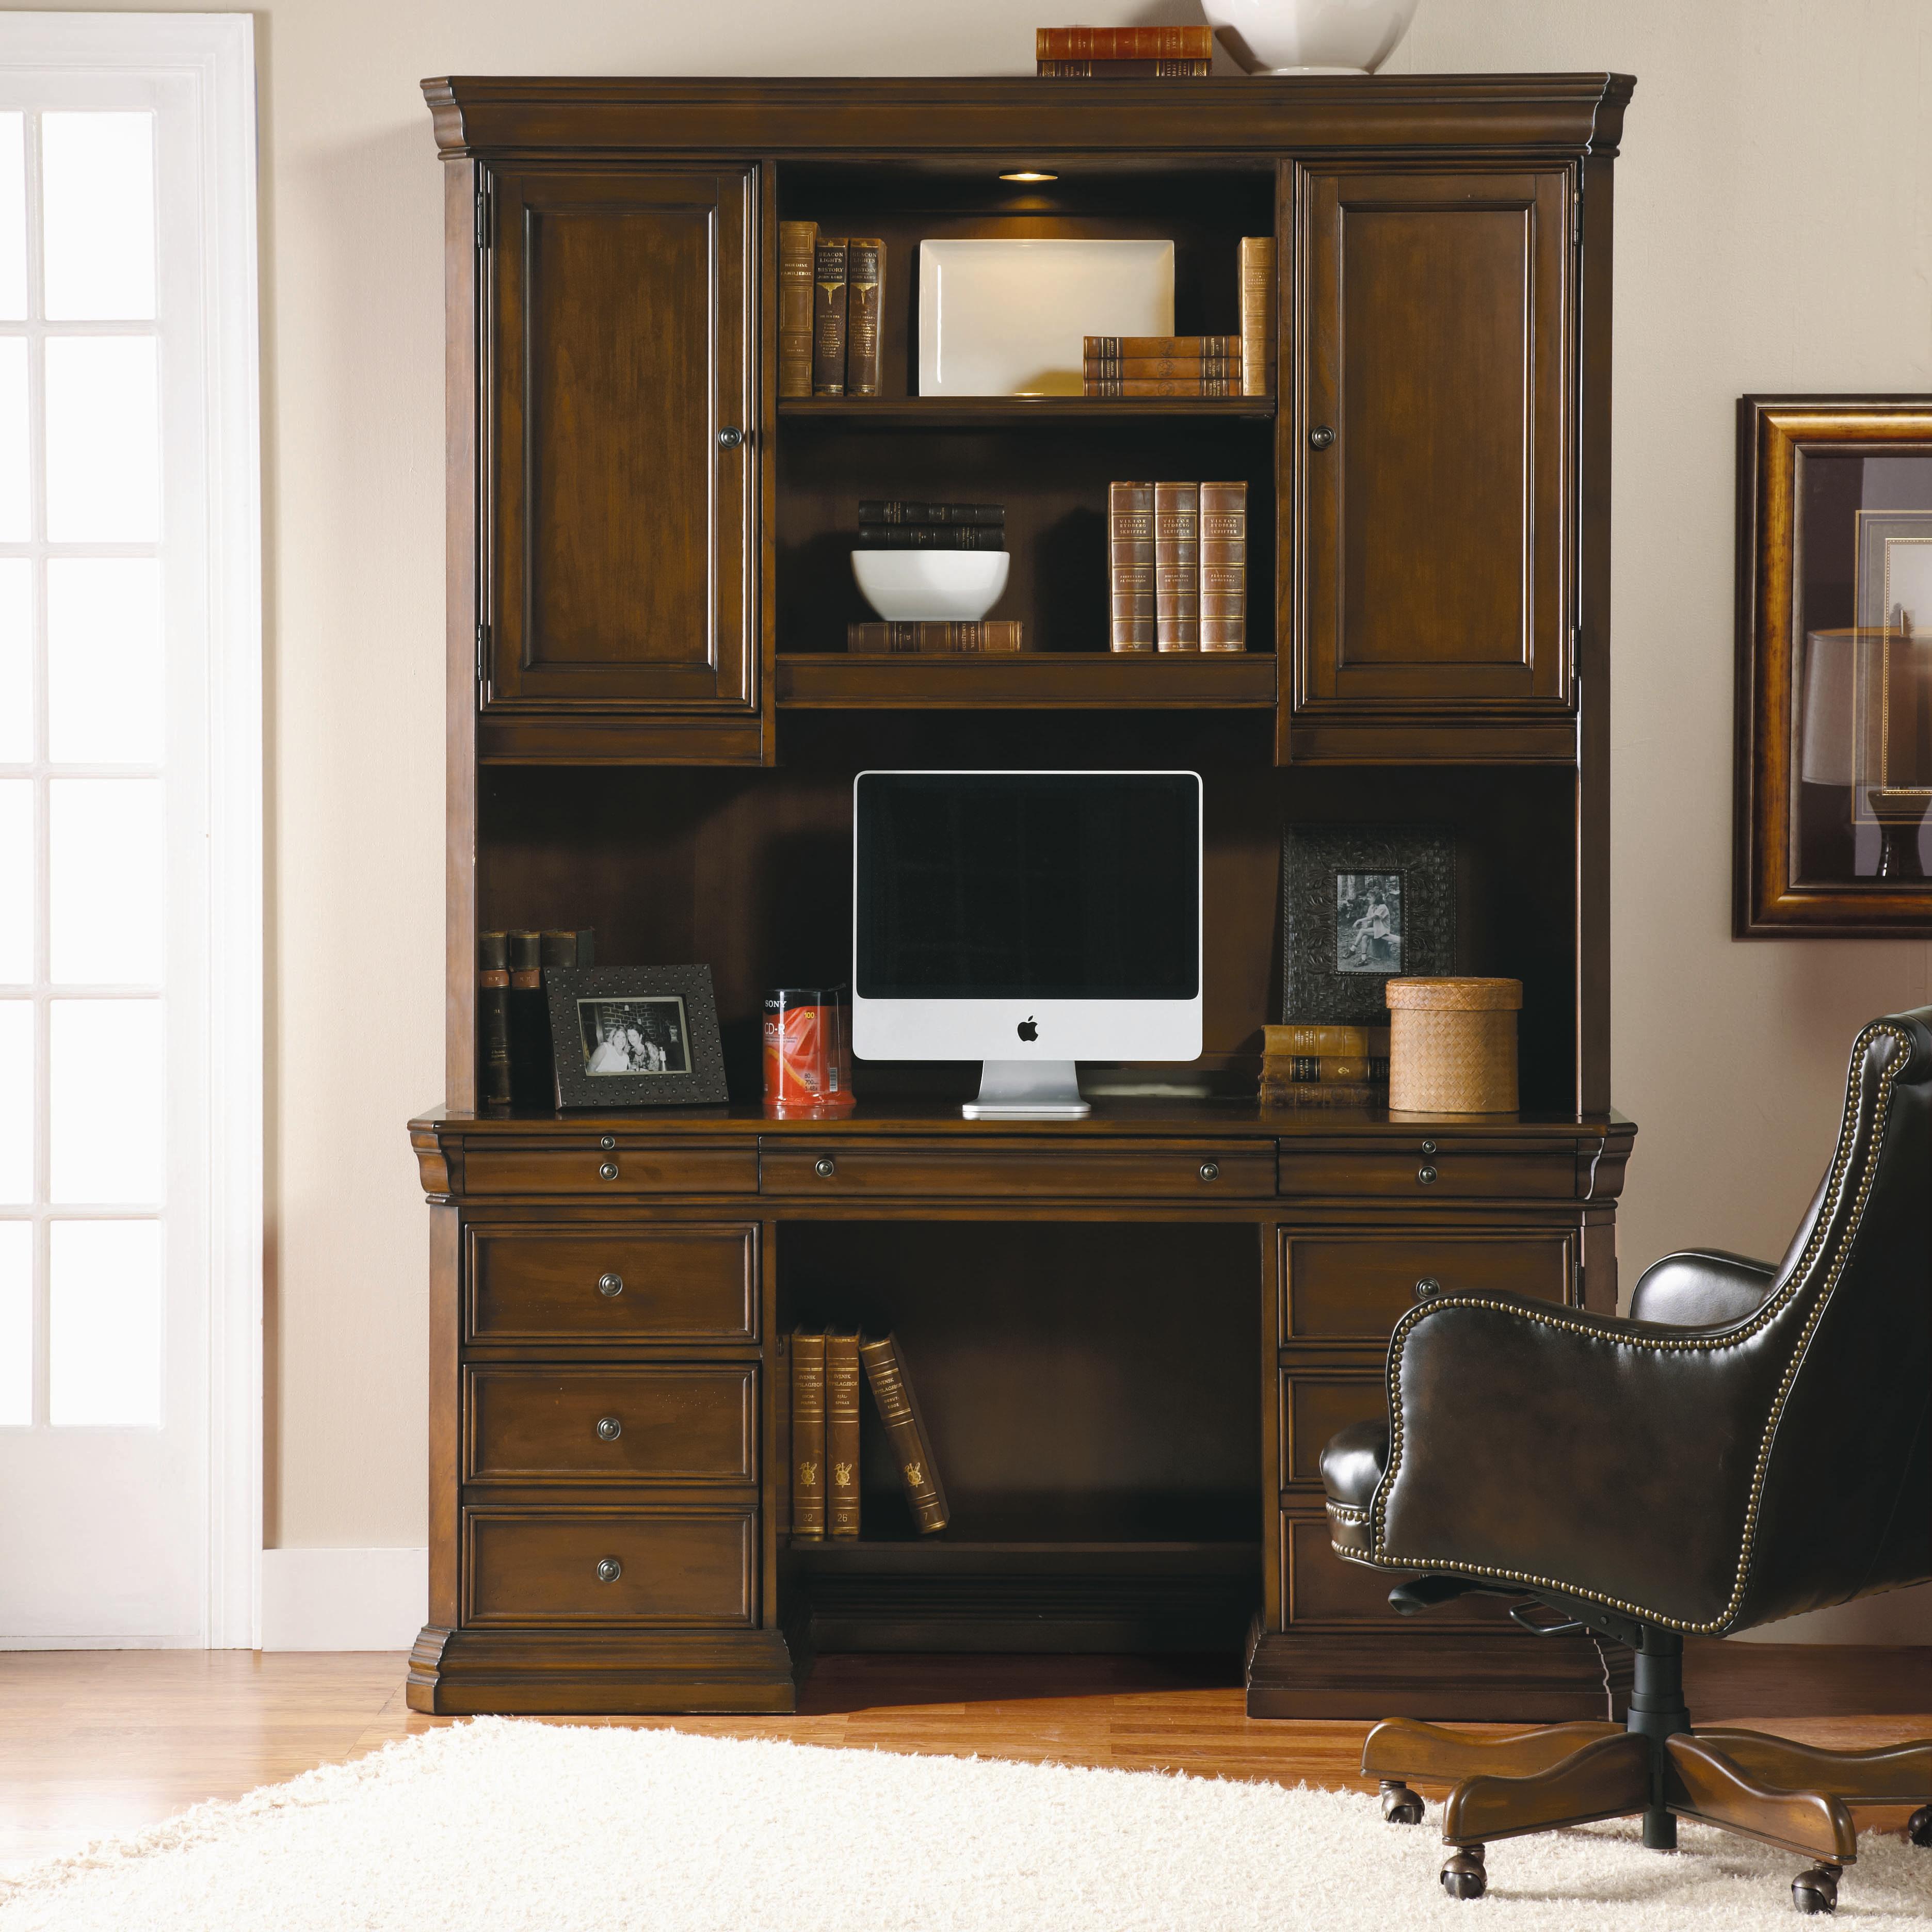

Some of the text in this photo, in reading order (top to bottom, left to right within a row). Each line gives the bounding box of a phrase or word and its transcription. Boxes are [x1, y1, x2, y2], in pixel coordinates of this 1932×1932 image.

[765, 1000, 787, 1008] SONY
[764, 1022, 785, 1035] CD-R
[876, 1377, 894, 1387] SVENSK
[803, 1514, 813, 1522] 22
[838, 1514, 848, 1522] 26
[923, 1512, 928, 1520] 7
